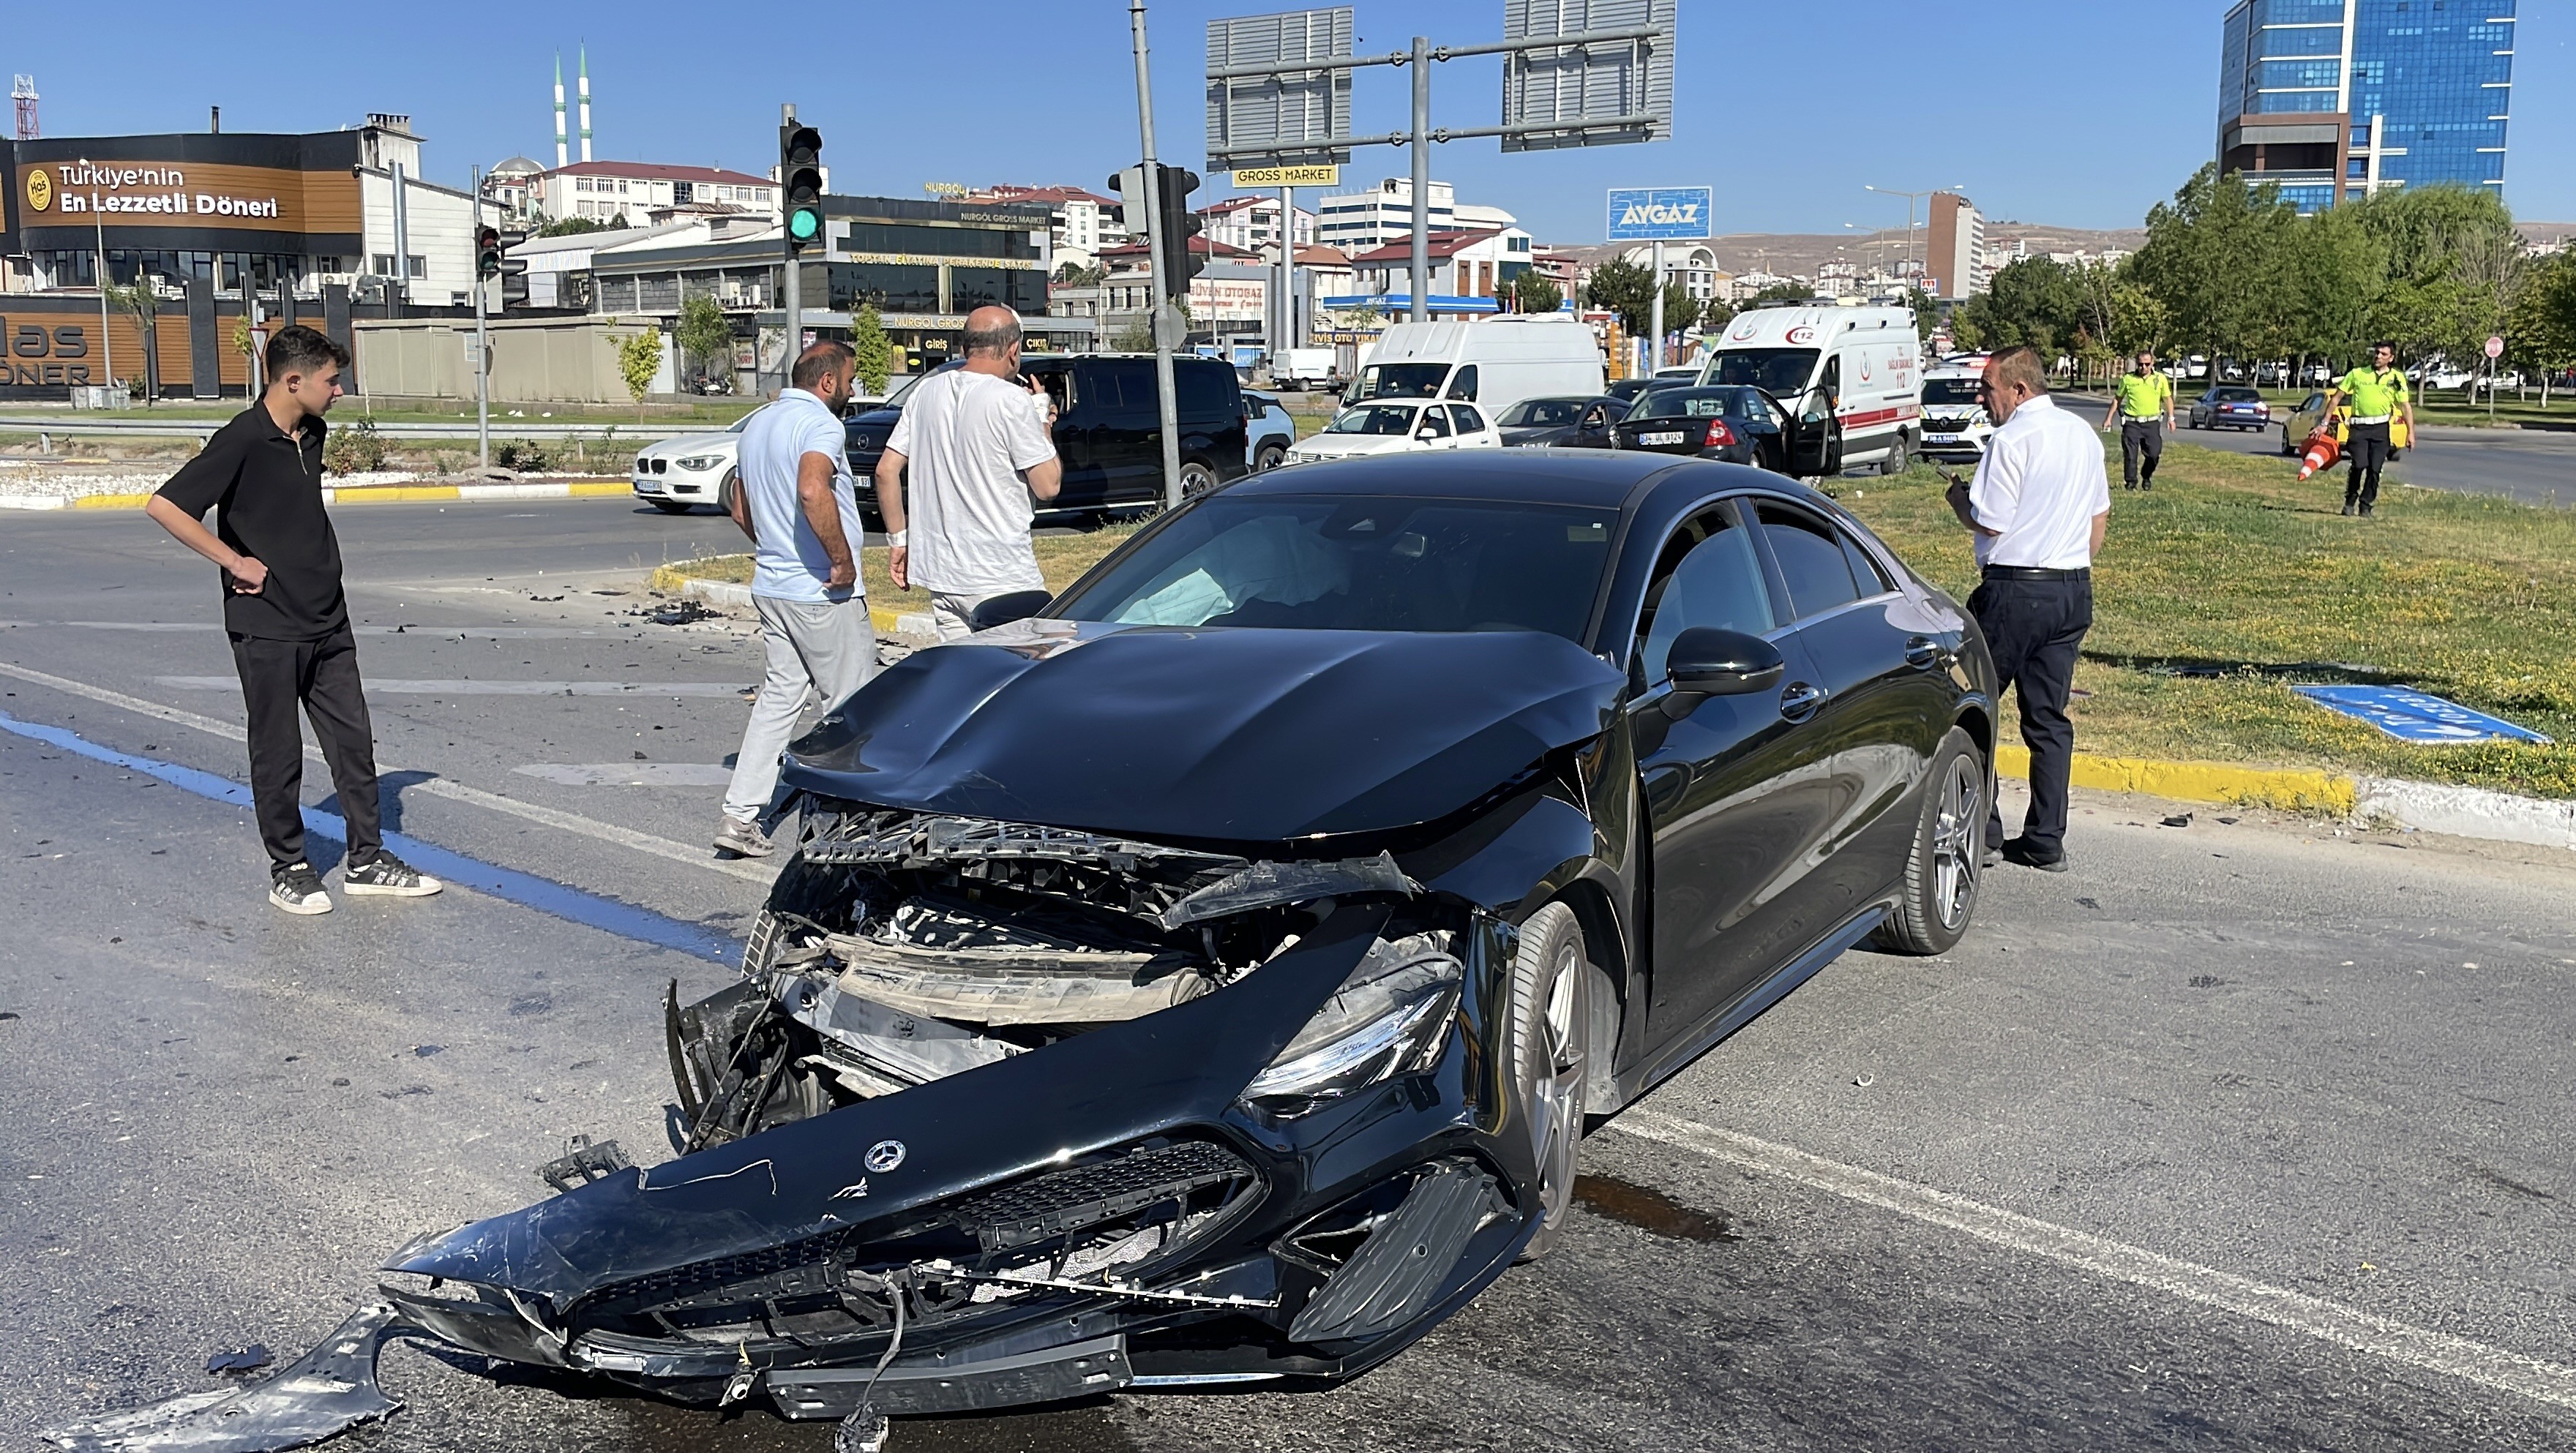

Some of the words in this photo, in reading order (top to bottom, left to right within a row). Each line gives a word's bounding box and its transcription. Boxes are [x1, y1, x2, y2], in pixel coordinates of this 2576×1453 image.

[59, 165, 184, 189] Türkiye'nin
[1238, 170, 1281, 181] GROSS
[1285, 169, 1332, 180] MARKET
[924, 181, 965, 195] NURGÖL
[61, 192, 86, 212] En
[92, 192, 188, 213] Lezzetli
[195, 195, 277, 218] Döneri
[961, 212, 991, 222] NURGÖL
[993, 214, 1017, 223] GROSS
[1018, 215, 1046, 225] MARKET
[1620, 202, 1698, 224] AYGAZ
[1224, 287, 1263, 299] OTOGAZ
[1366, 297, 1387, 305] AYGAZ
[894, 315, 935, 328] NURGÖL
[0, 315, 88, 358] as
[1334, 334, 1353, 343] OTO
[1794, 331, 1814, 340] 112
[925, 338, 948, 351] GİRİŞ
